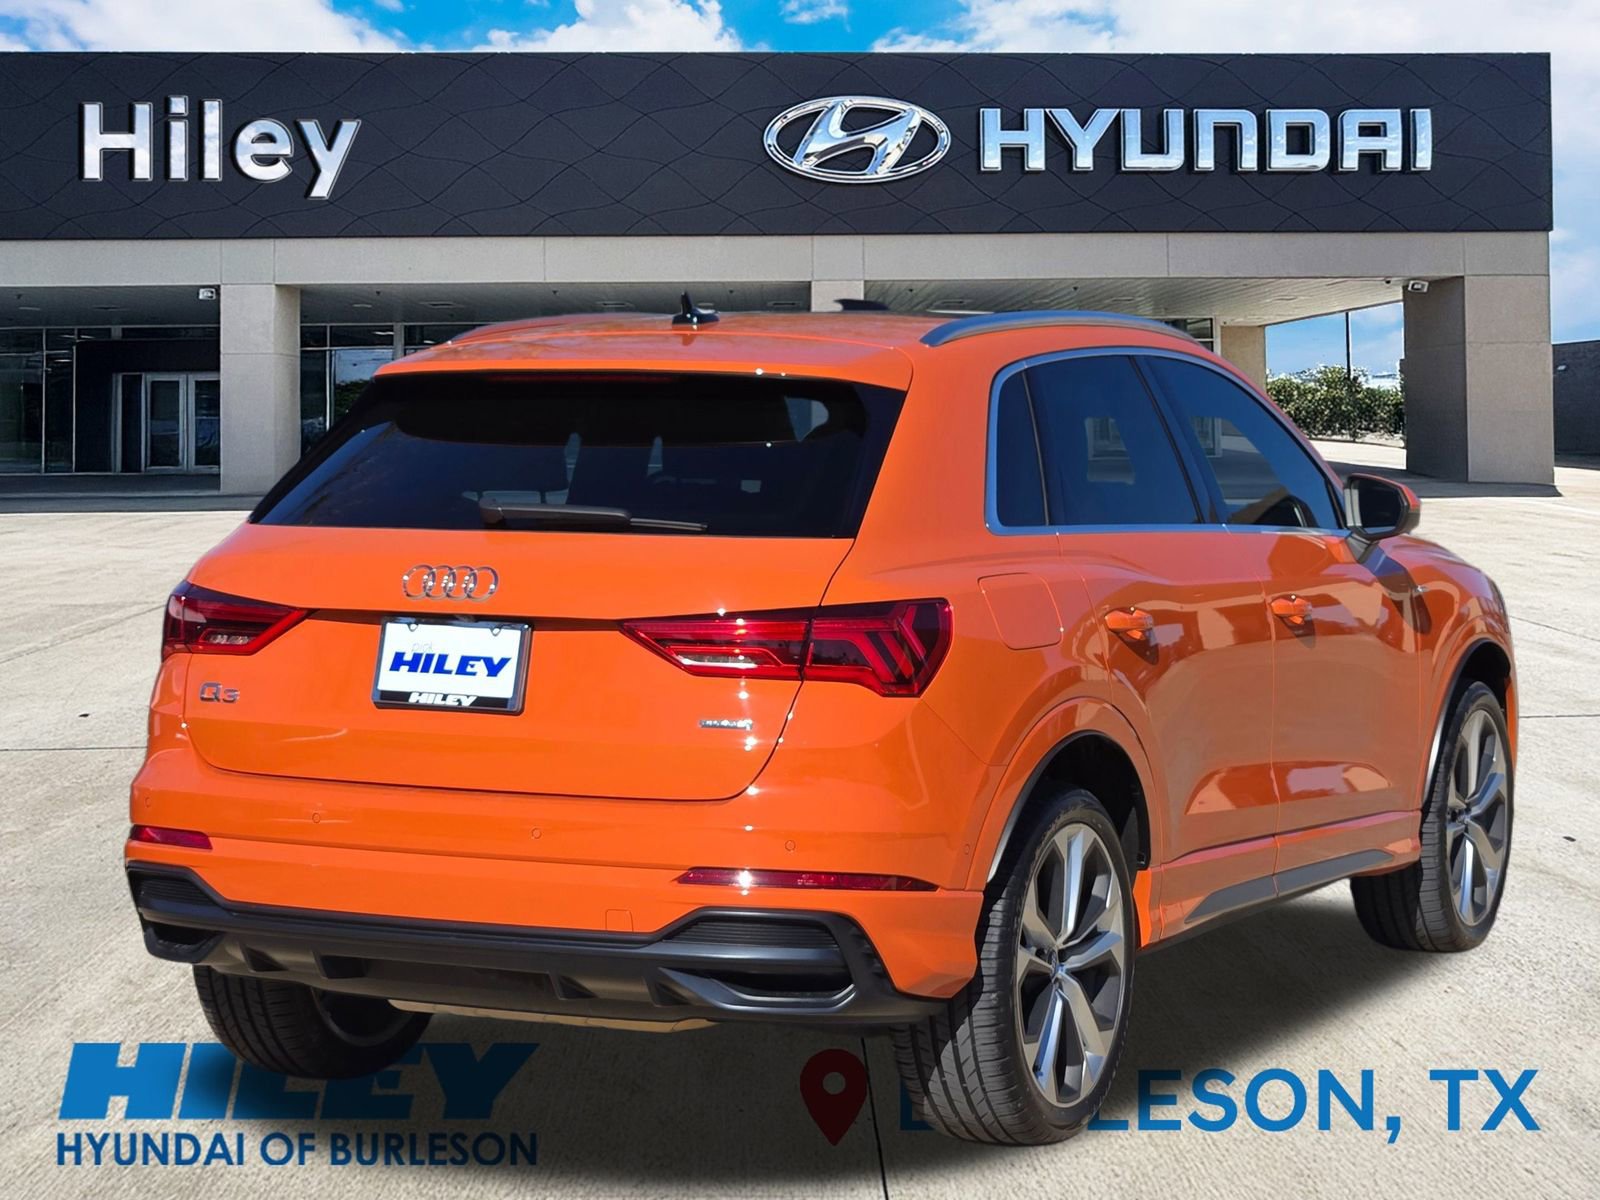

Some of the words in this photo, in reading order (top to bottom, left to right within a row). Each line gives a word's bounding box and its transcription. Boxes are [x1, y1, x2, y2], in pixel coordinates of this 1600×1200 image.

[80, 96, 361, 200] Hiley
[979, 107, 1433, 172] HYUNDAI
[389, 651, 512, 677] HILEY
[408, 691, 477, 707] HILEY
